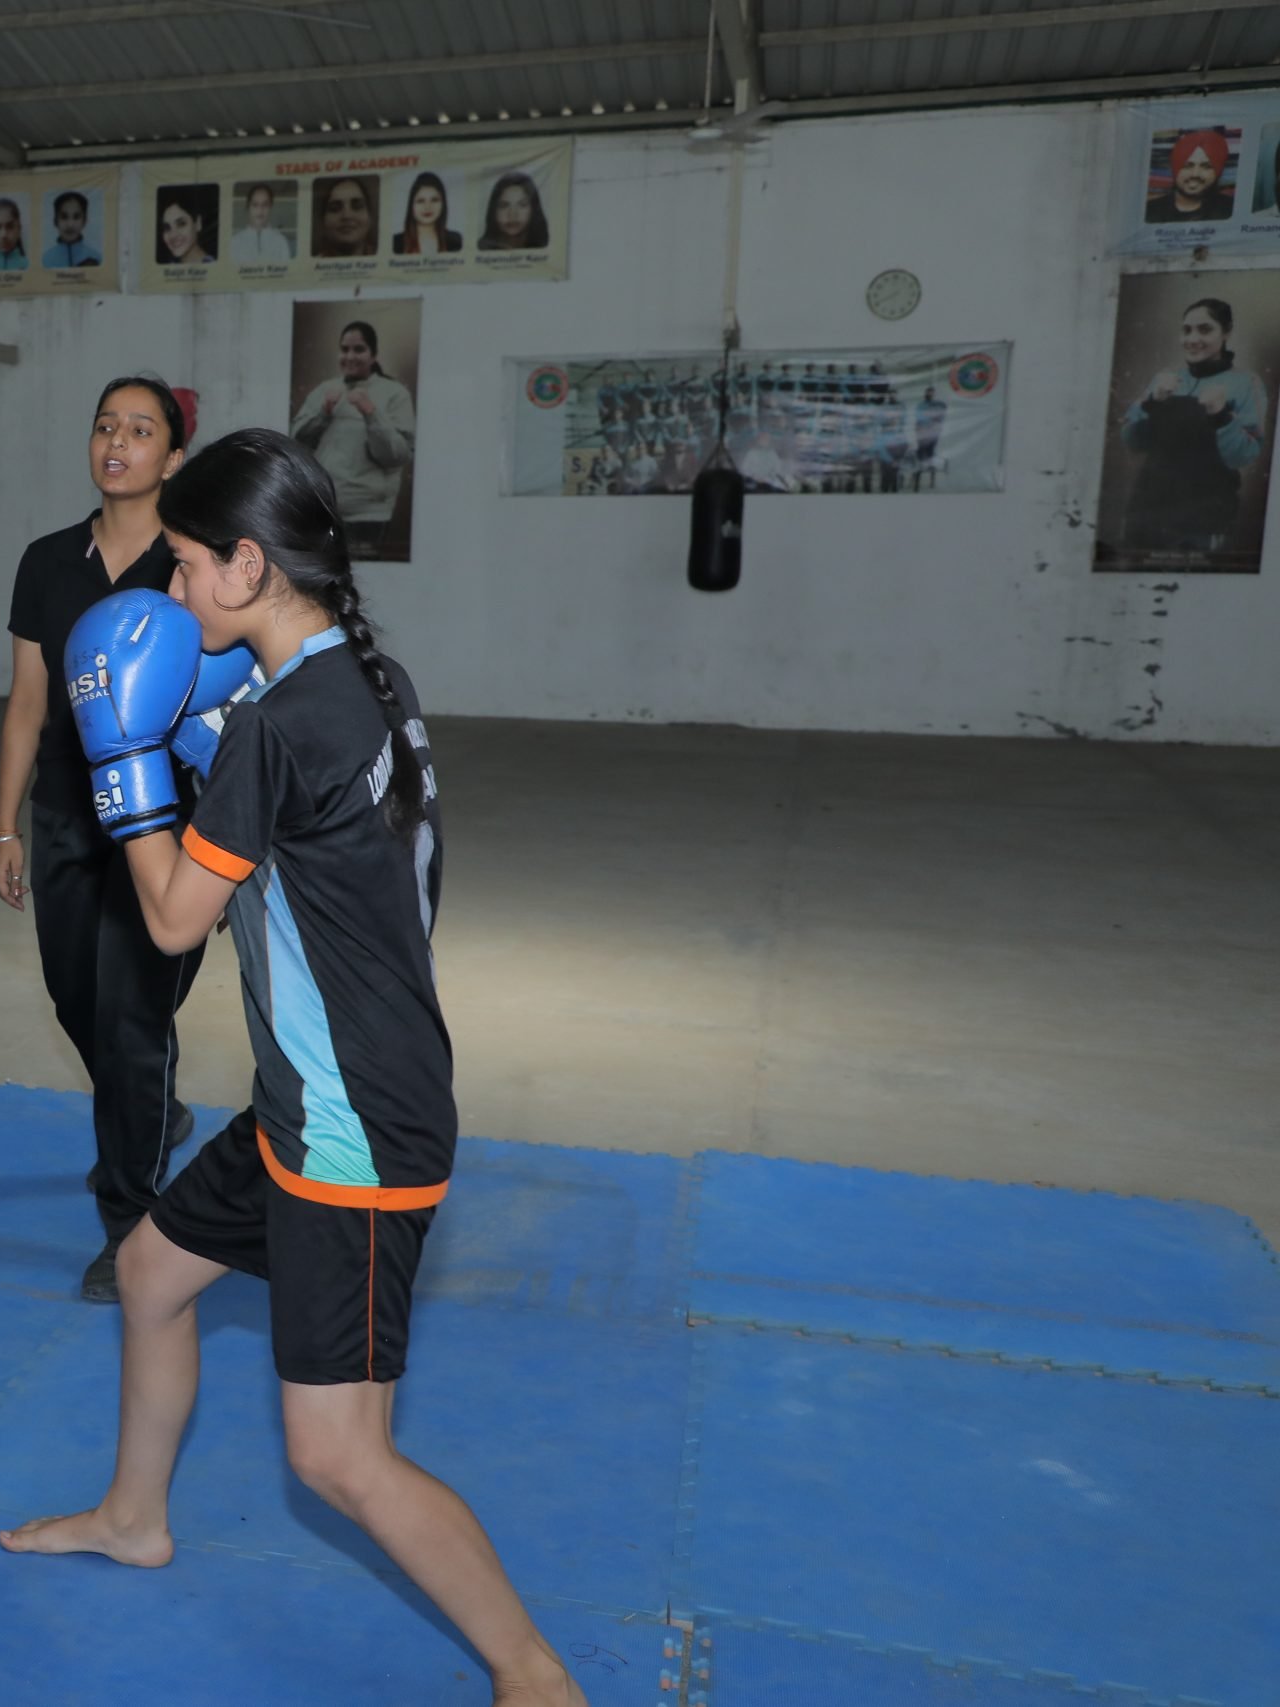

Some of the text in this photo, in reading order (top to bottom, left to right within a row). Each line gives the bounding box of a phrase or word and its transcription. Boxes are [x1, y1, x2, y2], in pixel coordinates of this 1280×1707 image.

[275, 155, 419, 175] STARS OF ACADEMY
